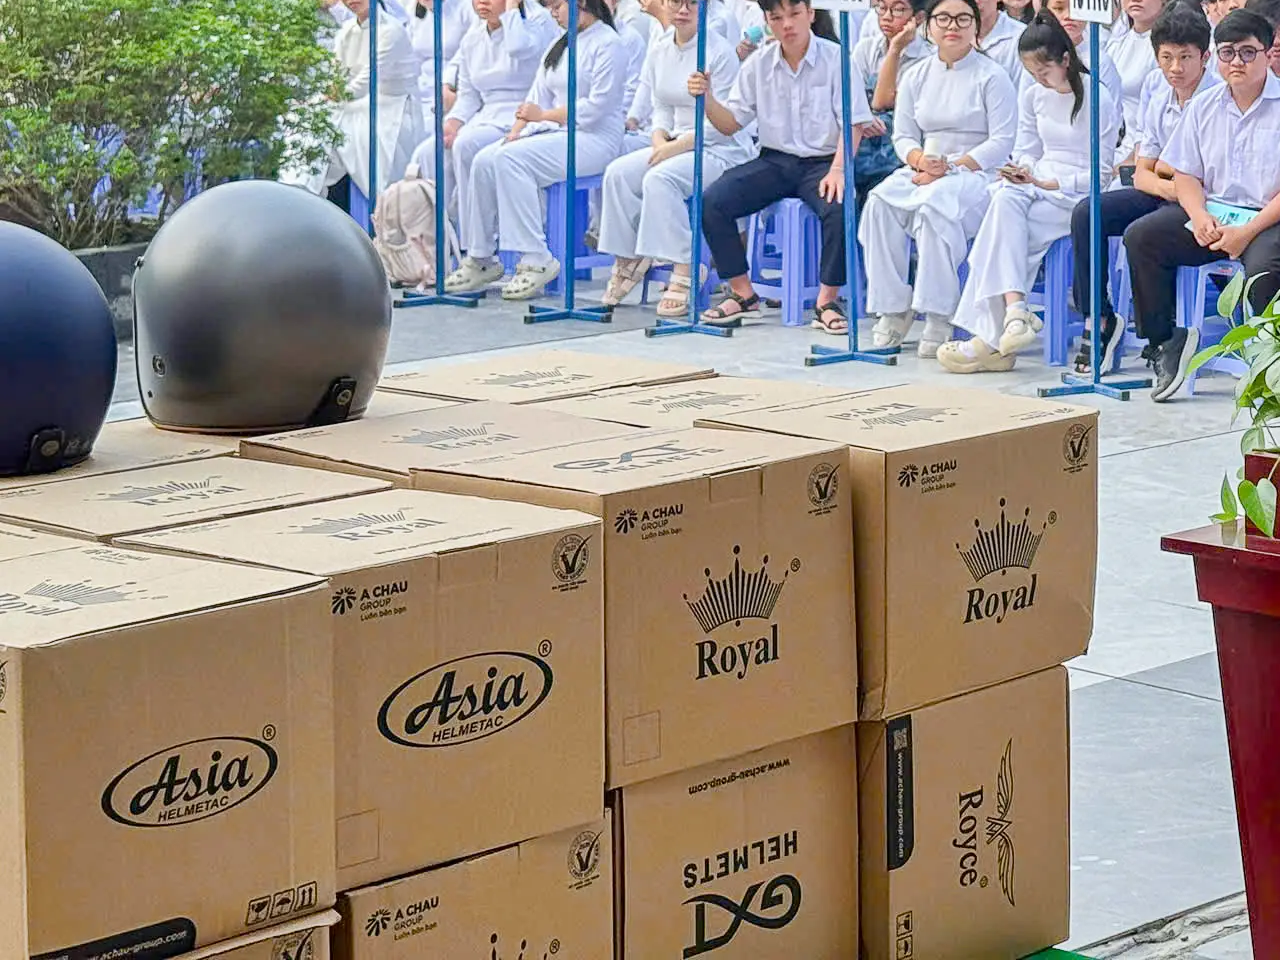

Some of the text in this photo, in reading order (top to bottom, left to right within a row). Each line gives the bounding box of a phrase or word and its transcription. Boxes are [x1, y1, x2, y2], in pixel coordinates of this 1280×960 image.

[921, 460, 957, 476] A CHAU
[641, 503, 684, 521] A CHAU
[641, 519, 669, 531] GROUP
[329, 518, 447, 541] Royal
[360, 598, 392, 611] GROUP
[361, 581, 408, 601] A CHAU
[963, 573, 1037, 624] Royal
[695, 623, 780, 680] Royal
[404, 666, 529, 735] Asia
[432, 715, 504, 743] HELMETAC
[129, 750, 253, 815] Asia
[688, 758, 791, 795] www.achau-group.com
[158, 796, 229, 823] HELMETAC
[952, 785, 984, 887] Royce
[683, 830, 798, 889] HELMETS
[394, 896, 439, 921] A CHAU
[394, 915, 423, 931] GROUP
